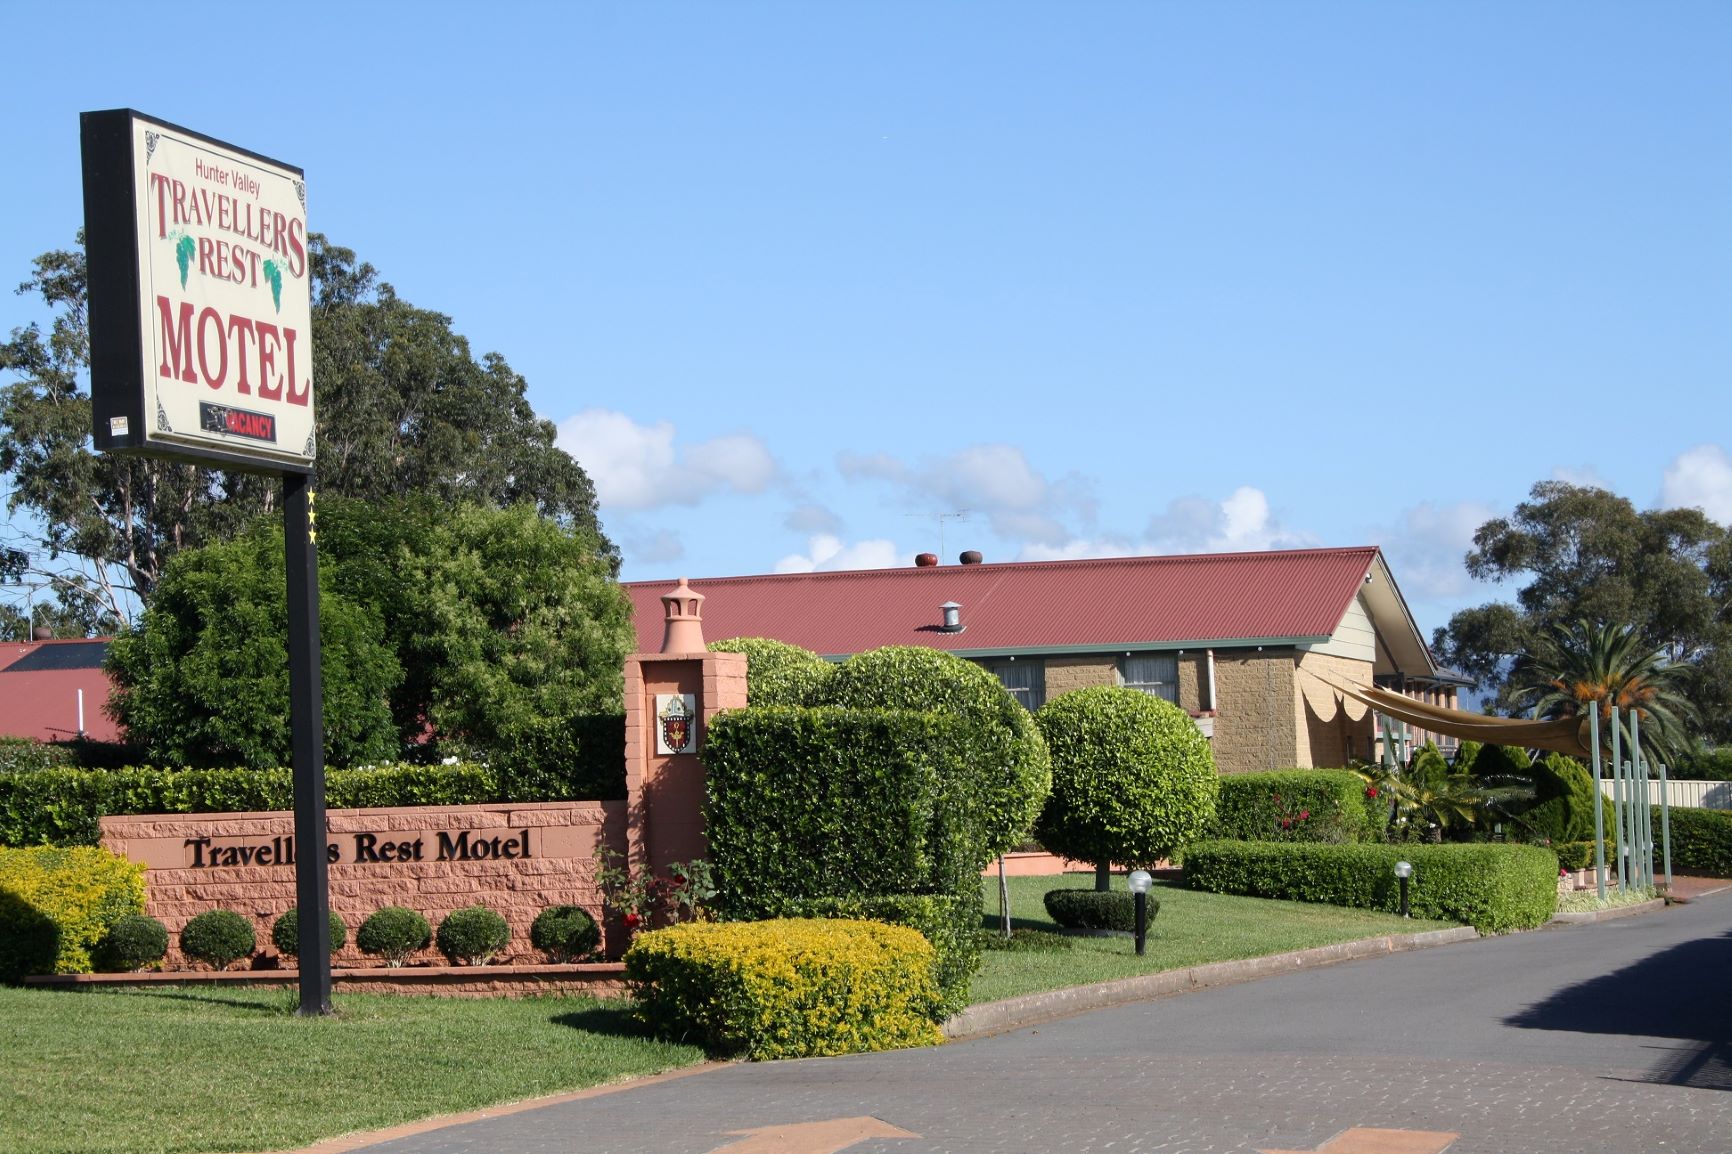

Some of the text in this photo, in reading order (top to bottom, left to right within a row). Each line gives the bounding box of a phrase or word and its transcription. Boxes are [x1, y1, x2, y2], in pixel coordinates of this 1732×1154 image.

[195, 157, 261, 200] Hunter Valley
[151, 172, 305, 279] TRAVELLERS
[198, 236, 261, 289] REST
[157, 295, 311, 407] MOTEL
[184, 829, 532, 869] Travells Rest Motel
